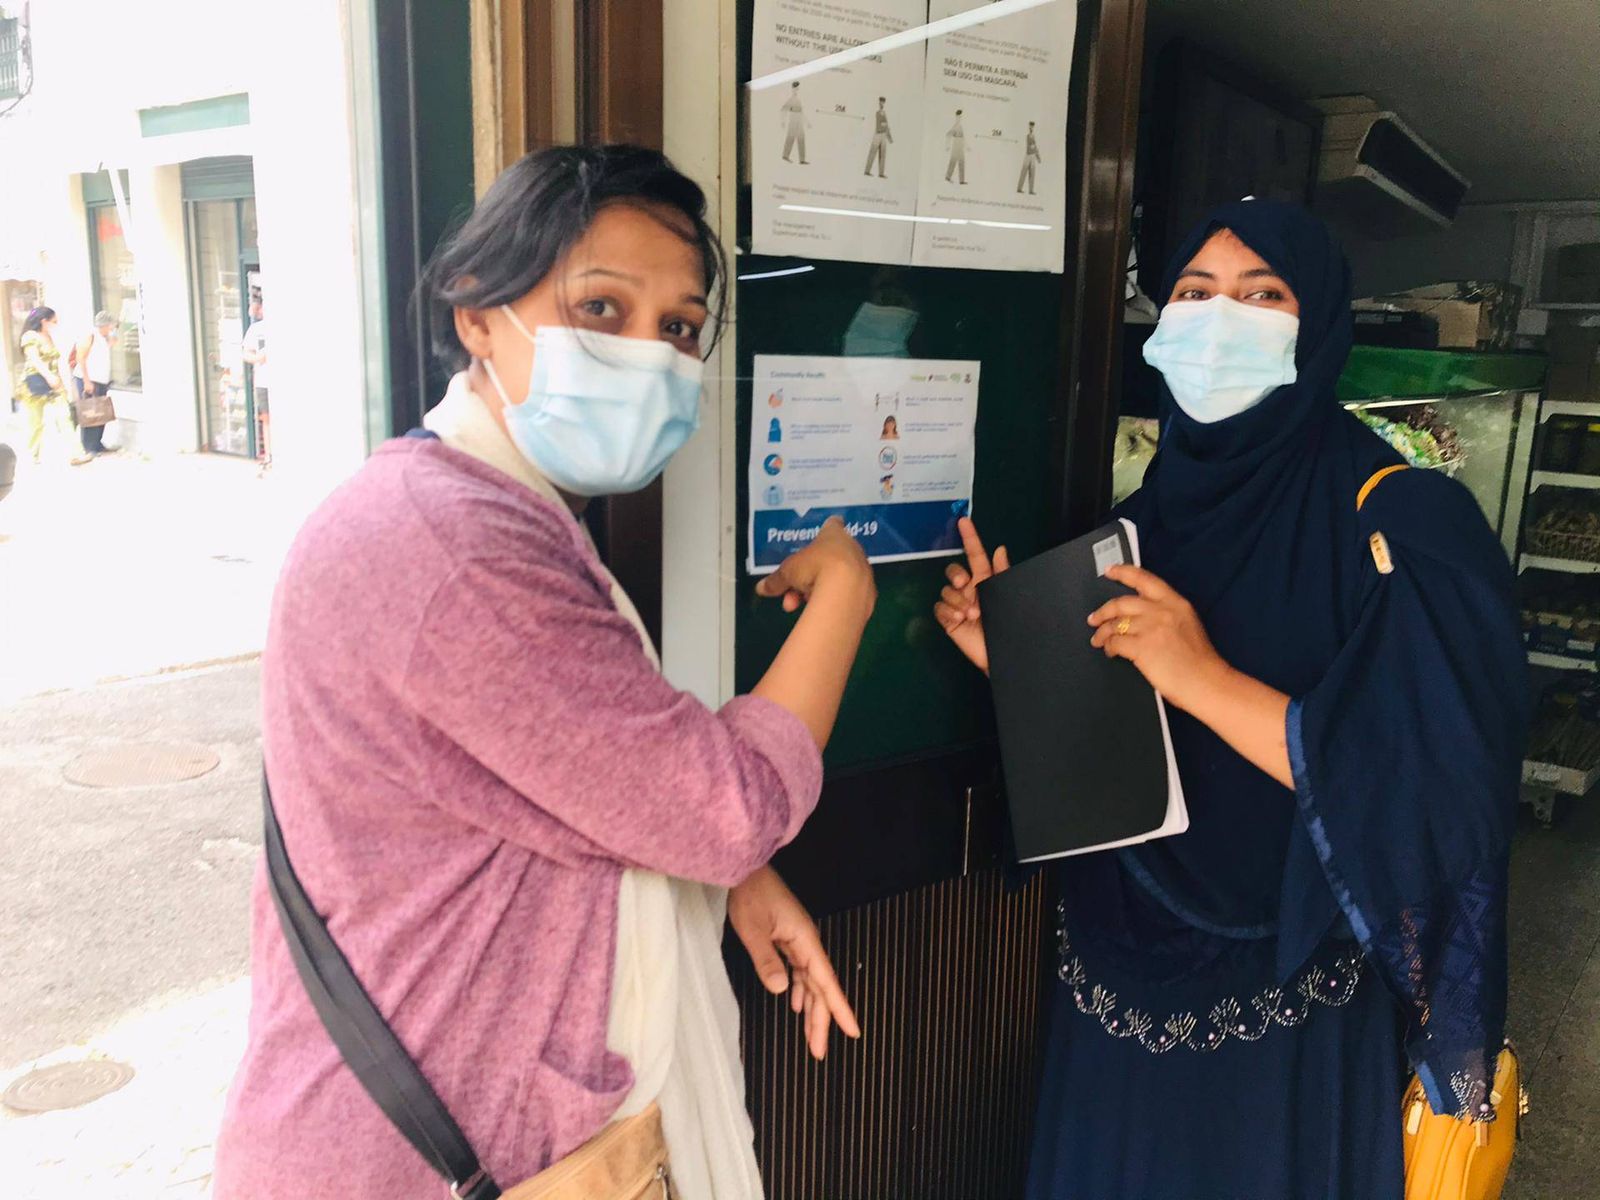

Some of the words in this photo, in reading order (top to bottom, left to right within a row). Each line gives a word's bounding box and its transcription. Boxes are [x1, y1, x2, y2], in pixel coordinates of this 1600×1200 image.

[775, 23, 788, 33] NO
[788, 25, 821, 40] ENTRIES
[822, 33, 838, 43] ARE
[775, 35, 811, 49] WITHOUT
[812, 42, 827, 53] THE
[767, 526, 820, 542] Prevent
